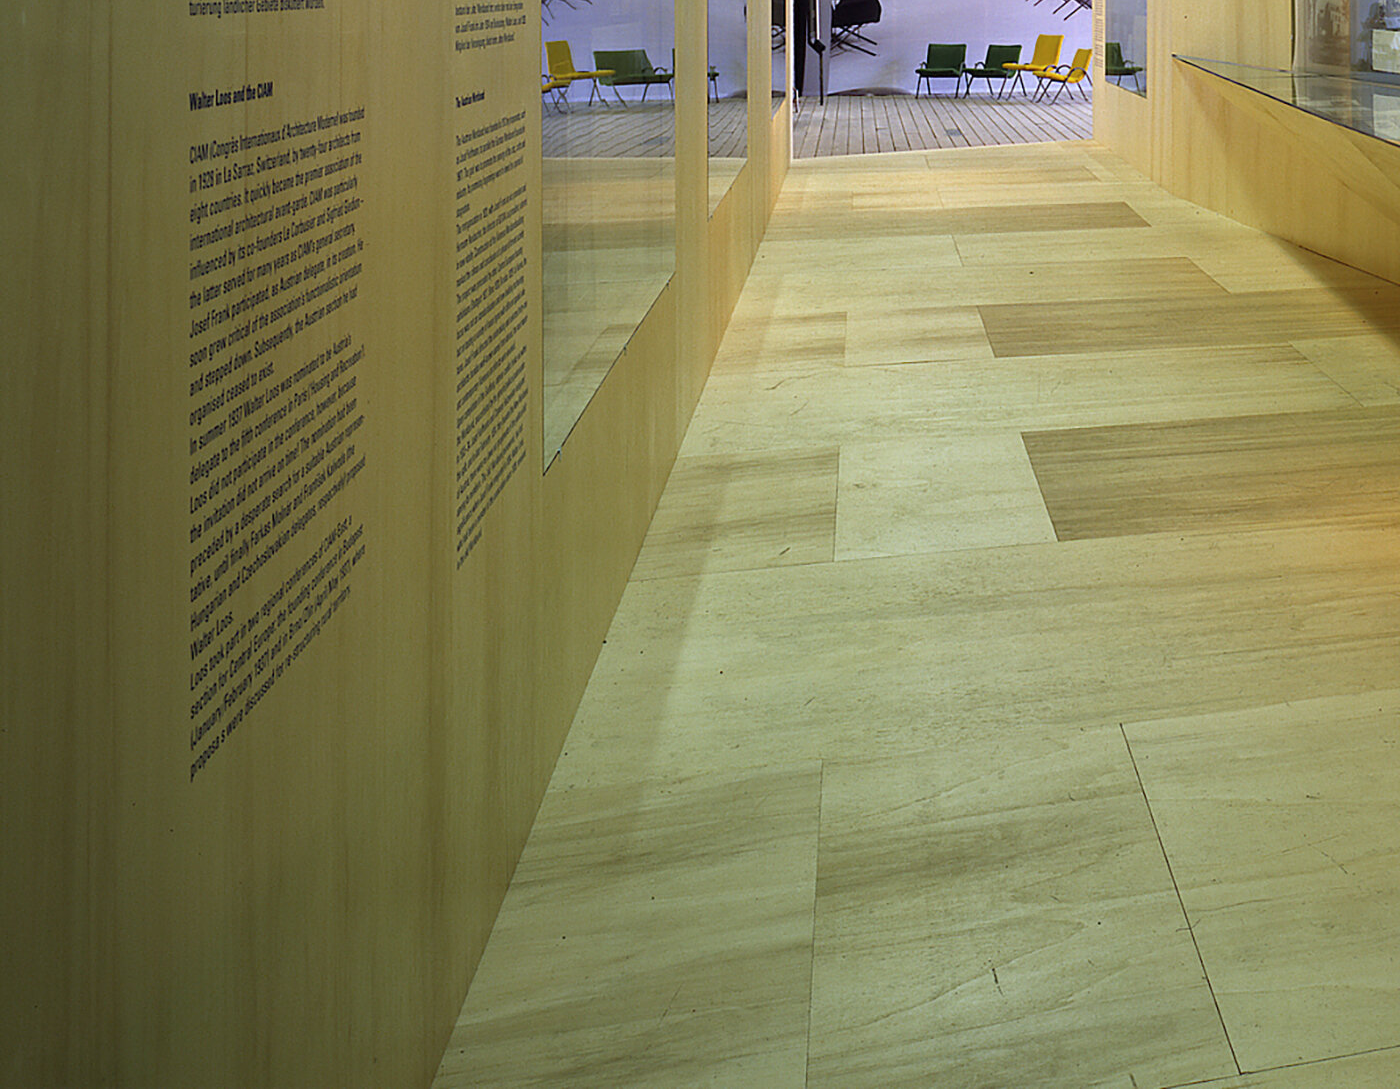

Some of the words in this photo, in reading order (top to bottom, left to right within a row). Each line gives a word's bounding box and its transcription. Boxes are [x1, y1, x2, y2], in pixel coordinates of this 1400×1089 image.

[189, 91, 214, 111] Walter
[215, 89, 231, 106] Loos
[233, 85, 245, 103] and
[246, 84, 255, 101] the
[257, 81, 273, 99] CIAM
[190, 143, 208, 164] CIAM
[198, 170, 214, 190] 1928
[190, 201, 208, 224] eight
[190, 219, 233, 251] international
[190, 250, 227, 280] influenced
[189, 291, 201, 309] the
[203, 283, 221, 302] latter
[223, 269, 245, 294] served
[189, 311, 210, 338] Josef
[211, 306, 230, 324] Frank
[189, 346, 207, 367] soon
[209, 337, 226, 361] grew
[228, 319, 250, 346] critical
[190, 373, 203, 396] and
[205, 356, 232, 387] stepped
[189, 388, 224, 426] organised
[226, 376, 249, 402] ceased
[198, 419, 227, 450] summer
[228, 405, 242, 427] 1937
[190, 452, 220, 485] delegate
[229, 438, 240, 456] the
[190, 490, 207, 514] Loos
[208, 477, 219, 500] did
[221, 470, 232, 489] not
[190, 523, 202, 543] the
[203, 497, 235, 532] invitation
[236, 484, 246, 506] did
[190, 530, 224, 577] preceded
[214, 554, 228, 581] until
[230, 539, 249, 566] finally
[190, 588, 226, 632] Hungarian
[228, 571, 240, 597] and
[190, 627, 214, 660] Walter
[190, 663, 208, 691] Loos
[209, 647, 224, 671] took
[225, 630, 239, 657] part
[190, 682, 217, 719] section
[218, 670, 228, 689] for
[229, 641, 252, 678] Central
[226, 708, 243, 736] were
